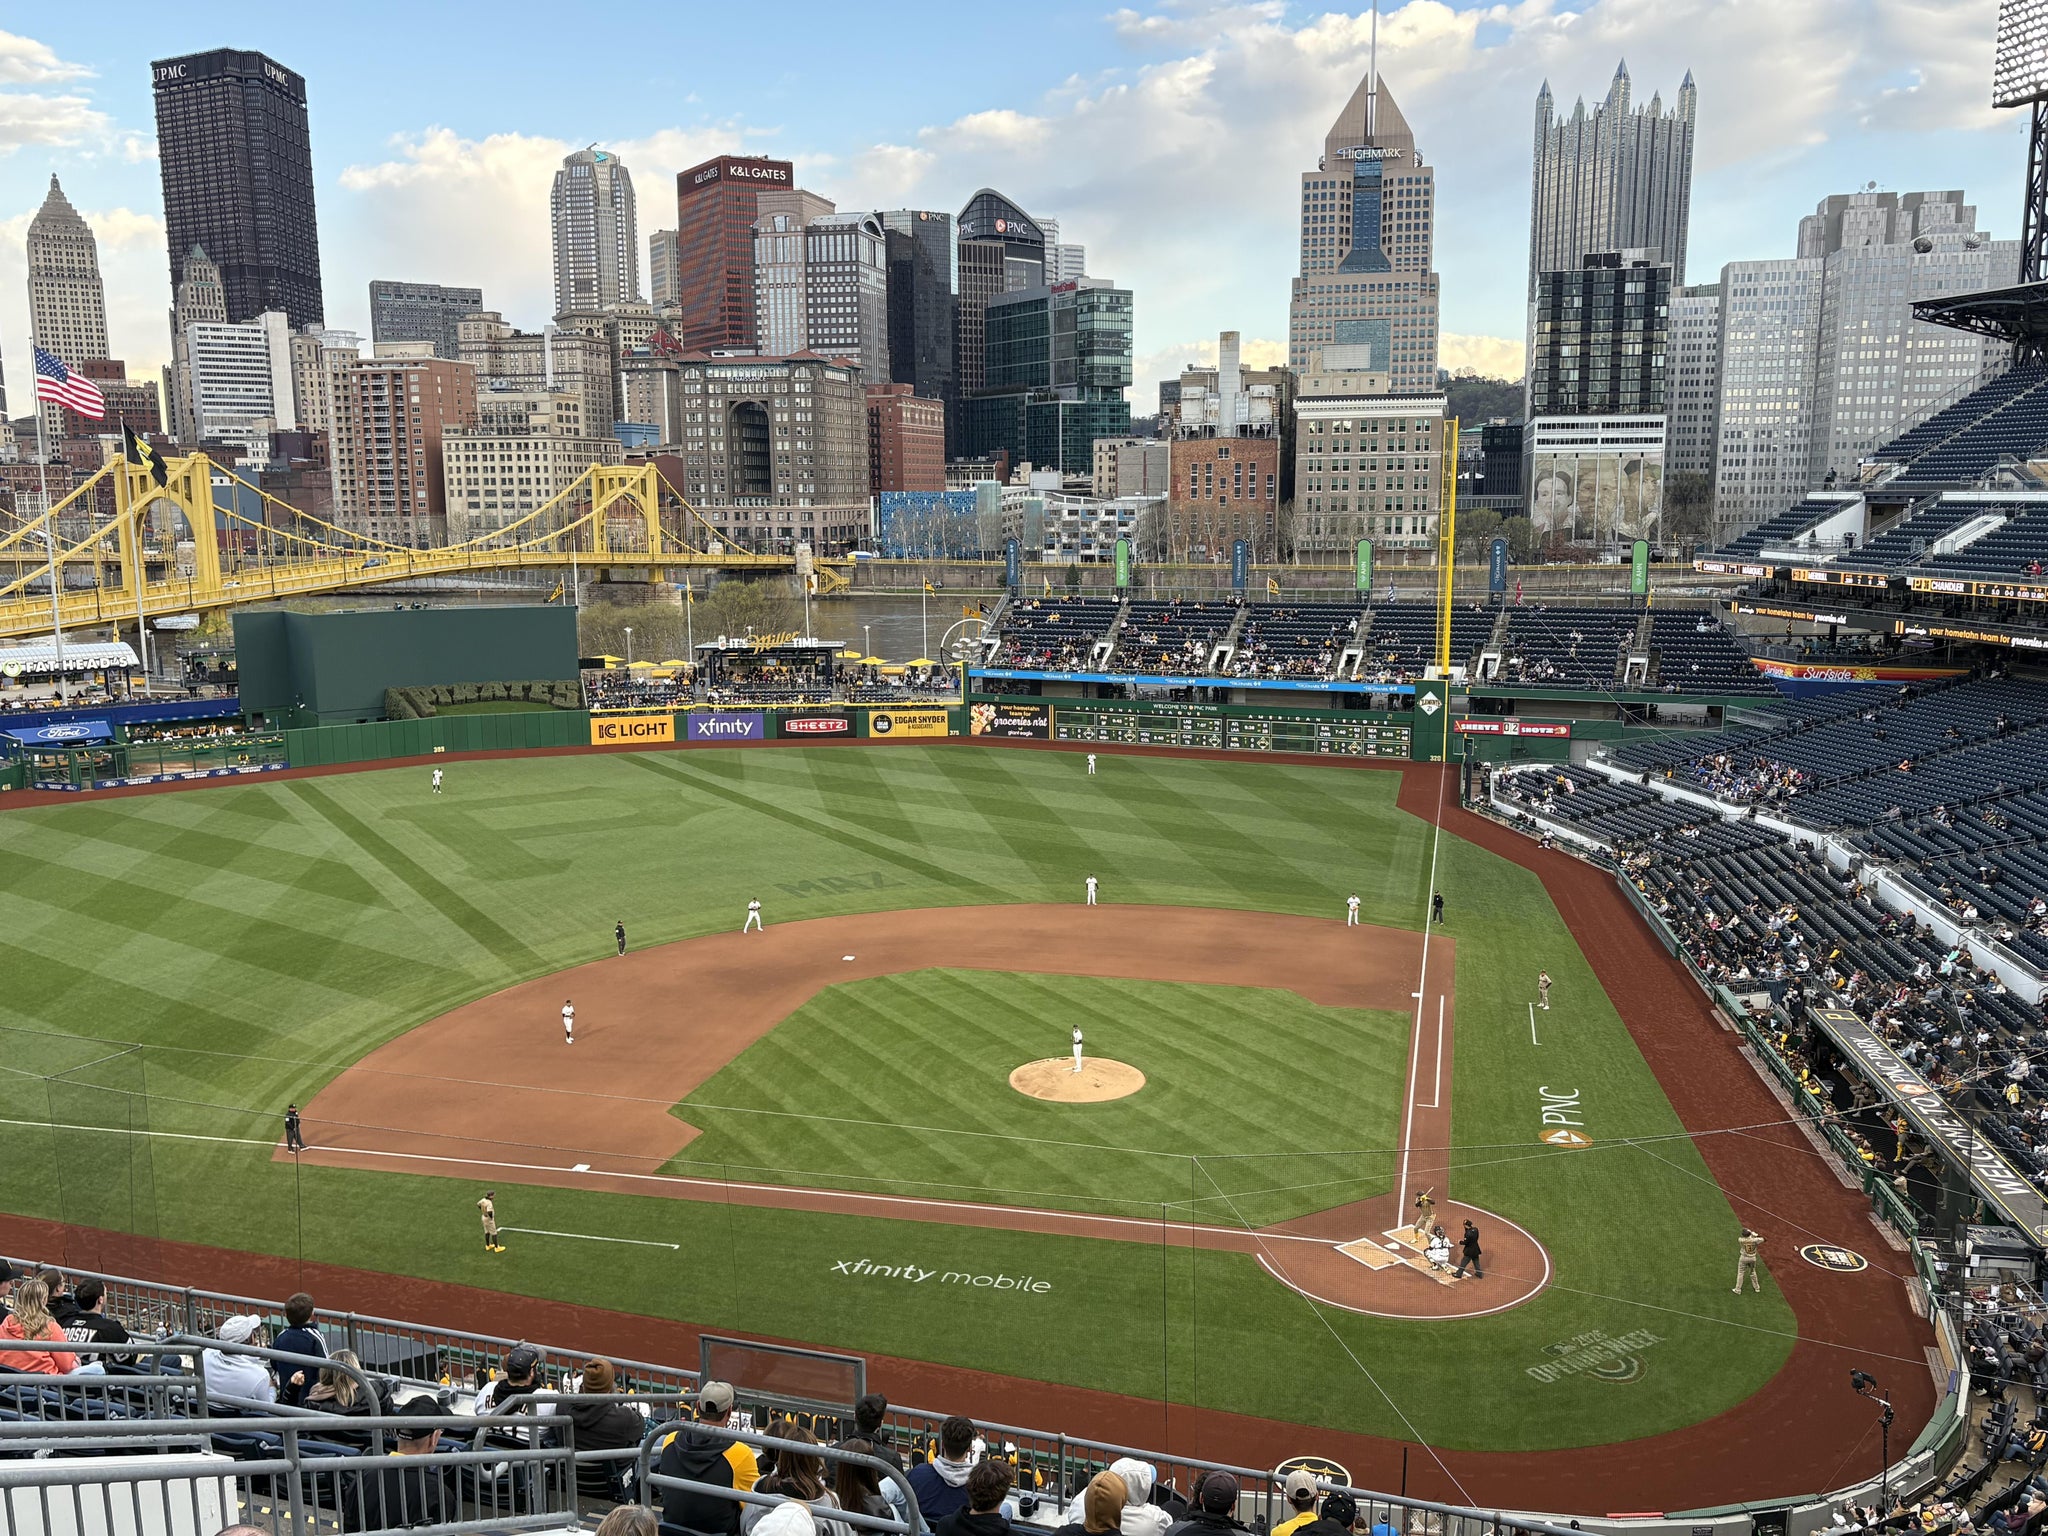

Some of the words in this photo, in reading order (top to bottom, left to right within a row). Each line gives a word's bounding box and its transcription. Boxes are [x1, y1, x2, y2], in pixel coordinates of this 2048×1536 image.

[152, 64, 187, 82] UPMC
[264, 62, 289, 86] UPMC
[1342, 147, 1402, 160] HIGHMARK
[703, 166, 718, 181] GATES
[729, 165, 750, 178] K&L
[751, 167, 786, 181] GATES
[928, 213, 944, 222] PNC
[960, 221, 975, 235] PNC
[1006, 222, 1028, 235] PNC
[1931, 580, 1964, 592] CHANDLER
[1756, 607, 1767, 615] your
[1792, 610, 1806, 619] team
[1806, 611, 1814, 619] for
[729, 638, 747, 649] IT'S
[745, 630, 801, 656] Miller
[792, 637, 819, 648] TIME
[1929, 627, 1945, 637] your
[1944, 627, 1980, 640] hometahn
[1980, 631, 1999, 642] team
[1999, 634, 2011, 644] for
[2011, 636, 2042, 647] groceries
[26, 660, 56, 674] FAT
[62, 655, 129, 671] HEAD'S
[1803, 666, 1852, 680] Surfside
[385, 679, 580, 721] PIRATES
[789, 720, 844, 730] SHEETZ
[895, 715, 917, 725] EDGAR
[918, 714, 946, 724] SNYDER
[994, 716, 1032, 728] groceries
[1032, 716, 1048, 727] n'at
[1248, 714, 1321, 722] AMERICAN
[48, 728, 81, 738] Ford
[598, 723, 617, 738] IC
[620, 722, 668, 737] LIGHT
[698, 717, 753, 737] xfinity
[1461, 723, 1500, 731] SHEETZ
[1521, 726, 1554, 734] SHOTZ
[1849, 1036, 1894, 1065] PARK
[1874, 1061, 1916, 1084] PNC
[1538, 1086, 1584, 1126] PNC
[1910, 1097, 1949, 1115] TO
[1930, 1117, 2031, 1196] WELCOME
[830, 1258, 937, 1283] xfinity
[940, 1272, 1052, 1293] mobile
[62, 1326, 98, 1344] ROSBY
[1525, 1344, 1618, 1383] OPENING
[1600, 1328, 1667, 1355] WEEK
